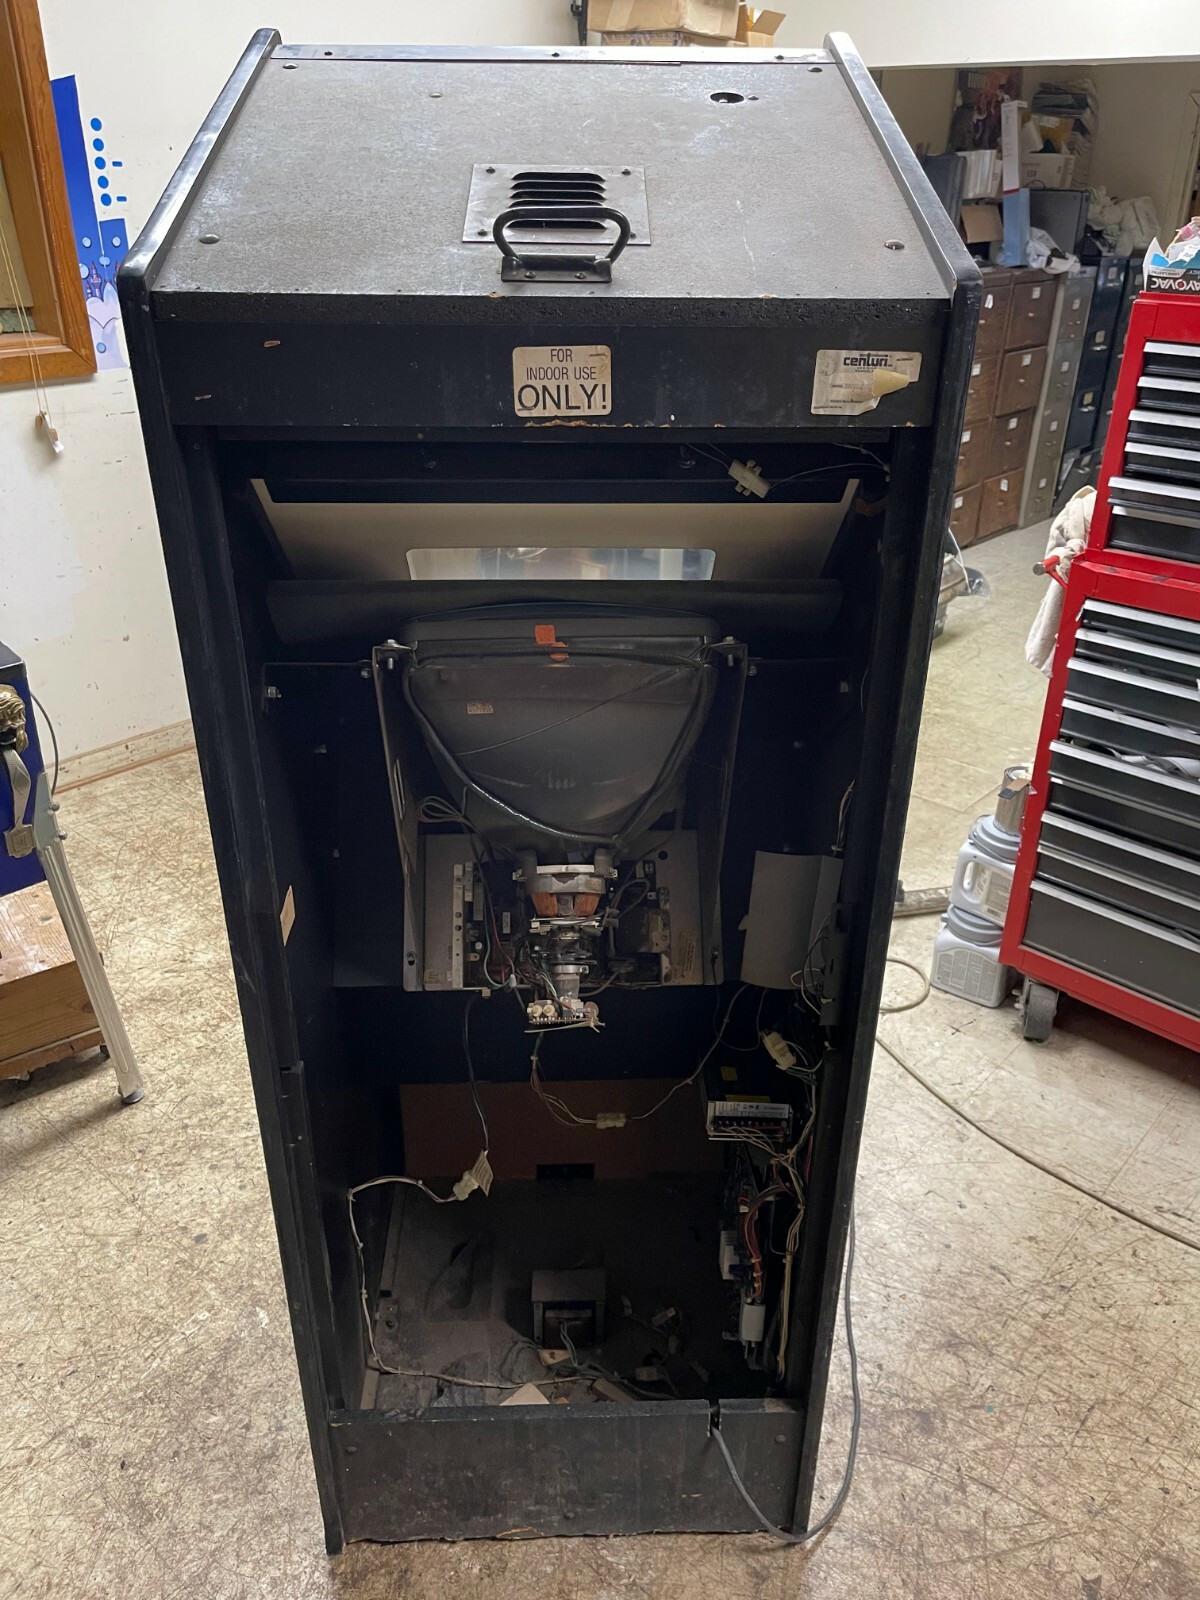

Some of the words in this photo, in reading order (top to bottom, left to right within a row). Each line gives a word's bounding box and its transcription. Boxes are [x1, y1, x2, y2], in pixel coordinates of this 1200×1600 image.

[550, 348, 573, 363] FOR
[526, 367, 568, 380] INDOOR
[574, 366, 597, 380] USE
[518, 384, 607, 411] ONLY!
